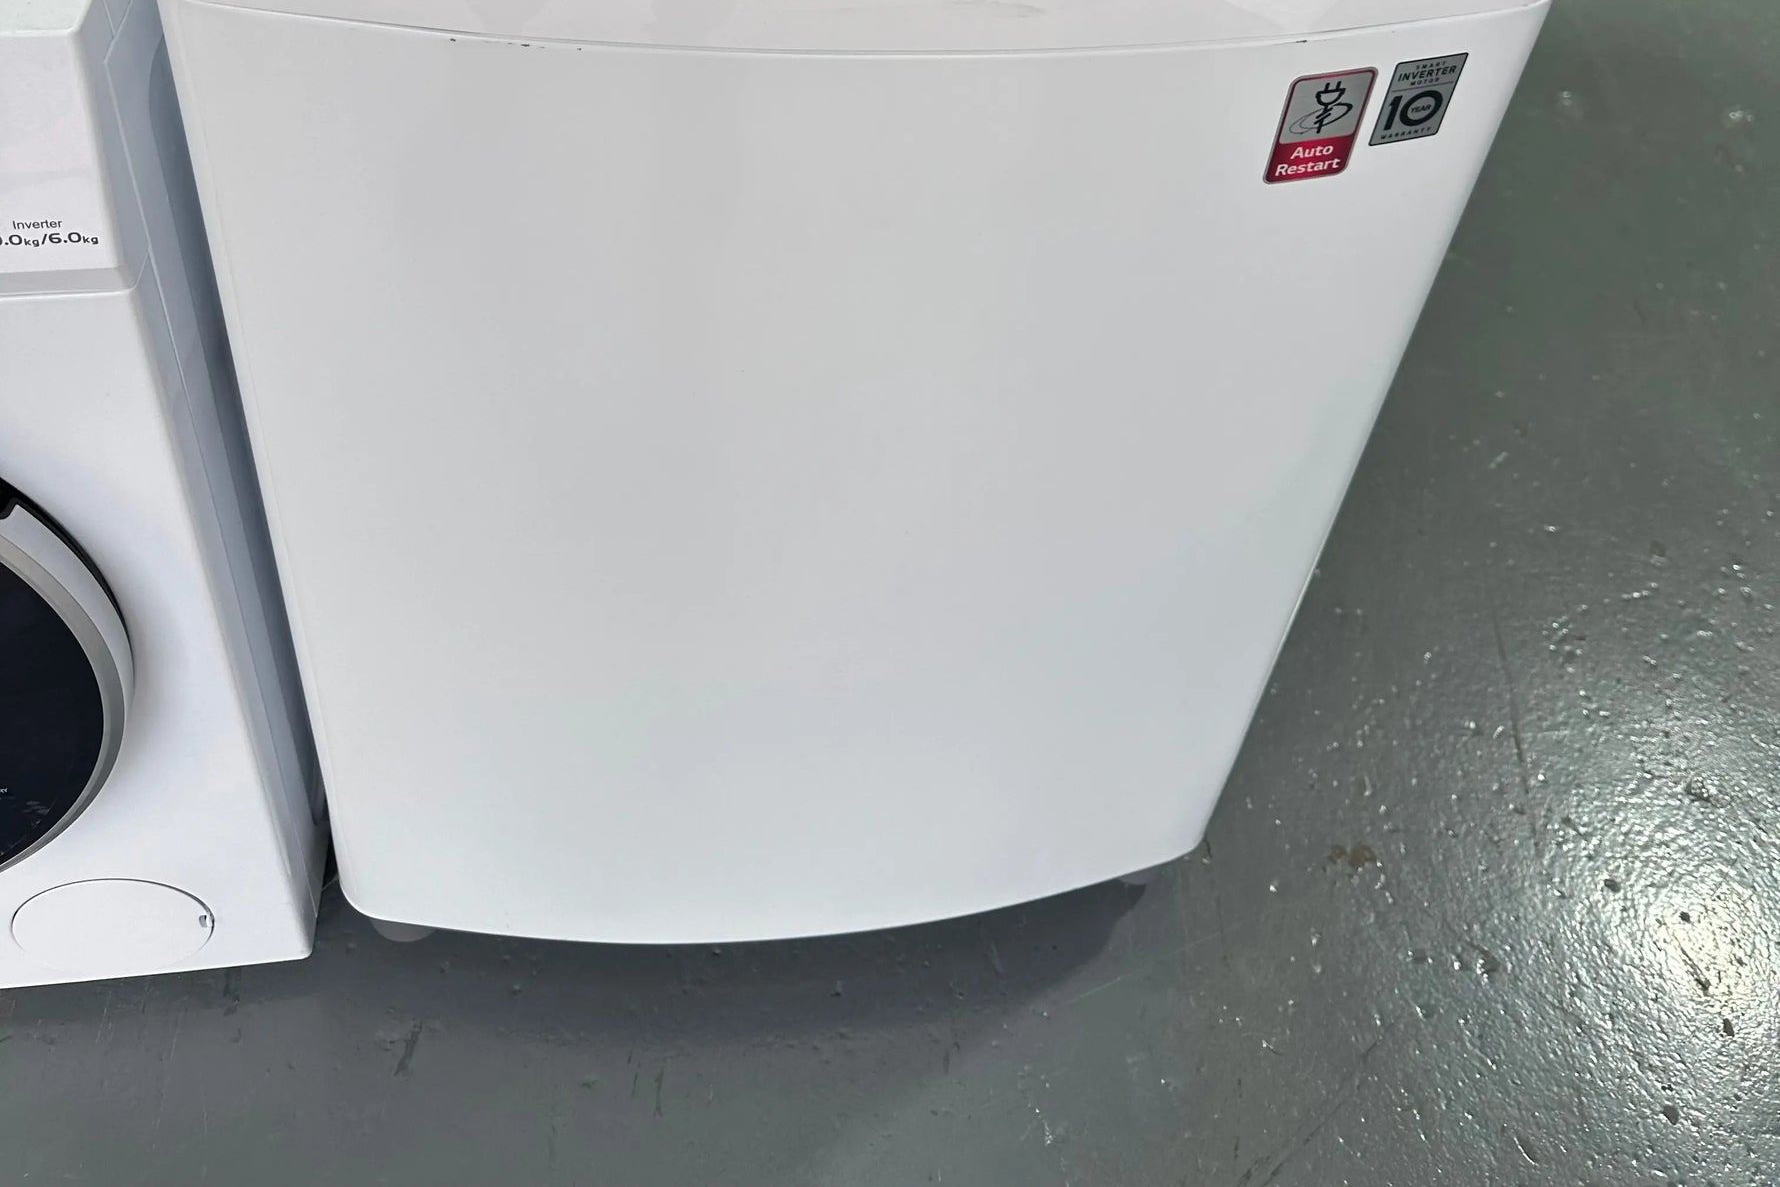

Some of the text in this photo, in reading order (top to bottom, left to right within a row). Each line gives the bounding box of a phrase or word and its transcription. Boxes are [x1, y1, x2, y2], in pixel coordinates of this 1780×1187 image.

[1415, 61, 1448, 70] SMART
[1397, 65, 1457, 82] INVERTER
[1410, 77, 1441, 86] MOTOR
[1384, 89, 1444, 131] 10
[1410, 104, 1432, 114] YEAR
[1380, 126, 1432, 140] WARRANTY
[1290, 145, 1334, 160] Auto
[1275, 158, 1341, 176] Restart
[12, 219, 63, 230] Inverter
[0, 231, 99, 248] .0kg/6.0kg
